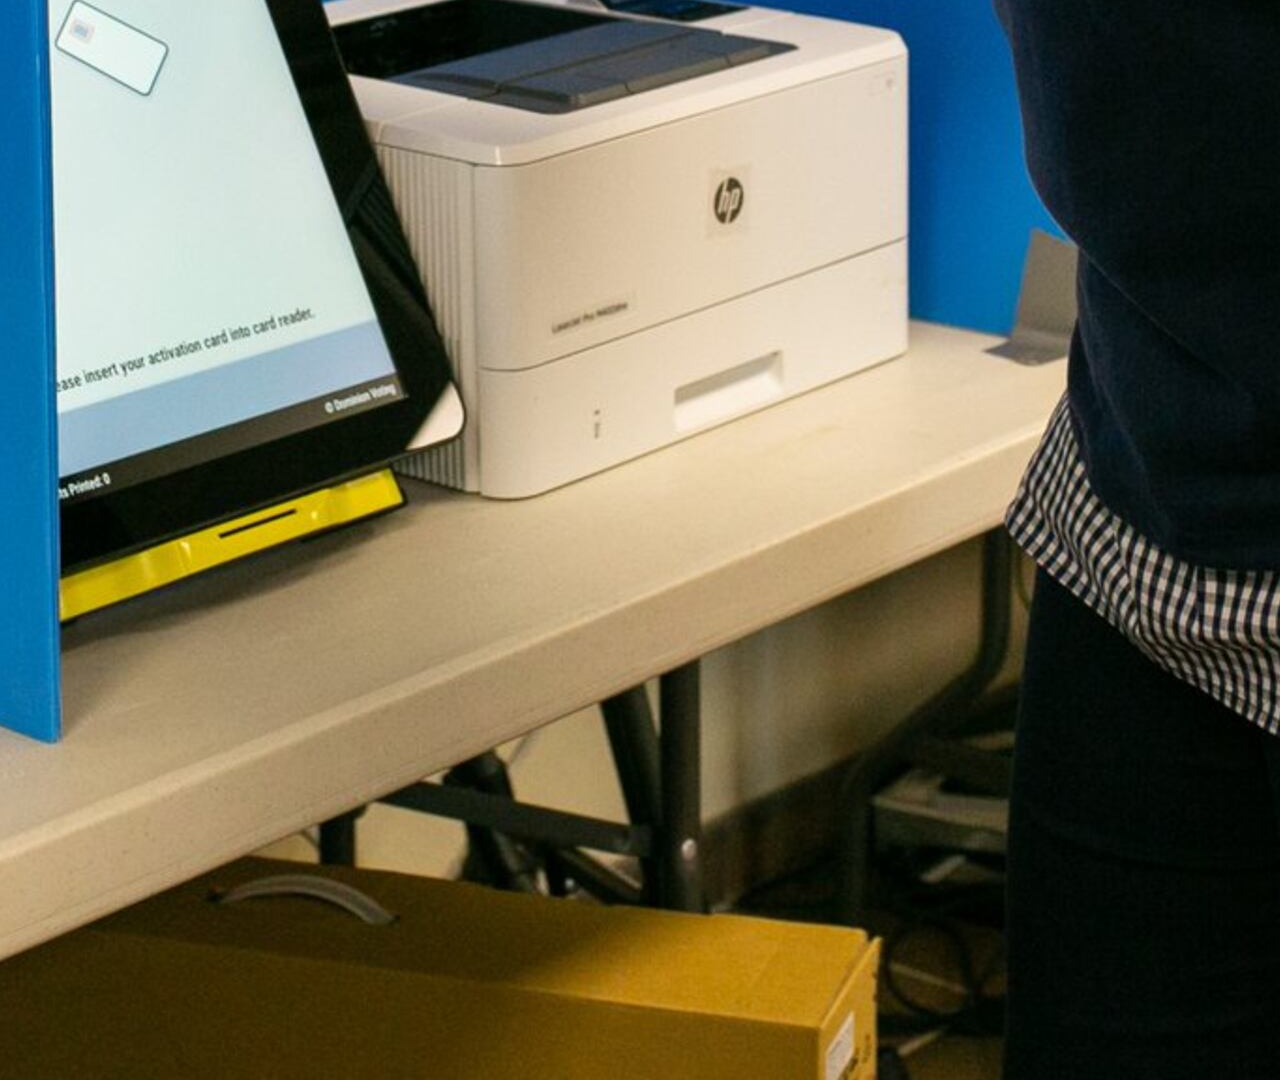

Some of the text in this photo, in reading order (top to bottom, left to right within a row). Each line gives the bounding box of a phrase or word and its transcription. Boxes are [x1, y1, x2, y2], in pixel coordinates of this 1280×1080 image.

[715, 178, 742, 224] hp
[56, 307, 316, 393] ease insert your activation card into card reader.
